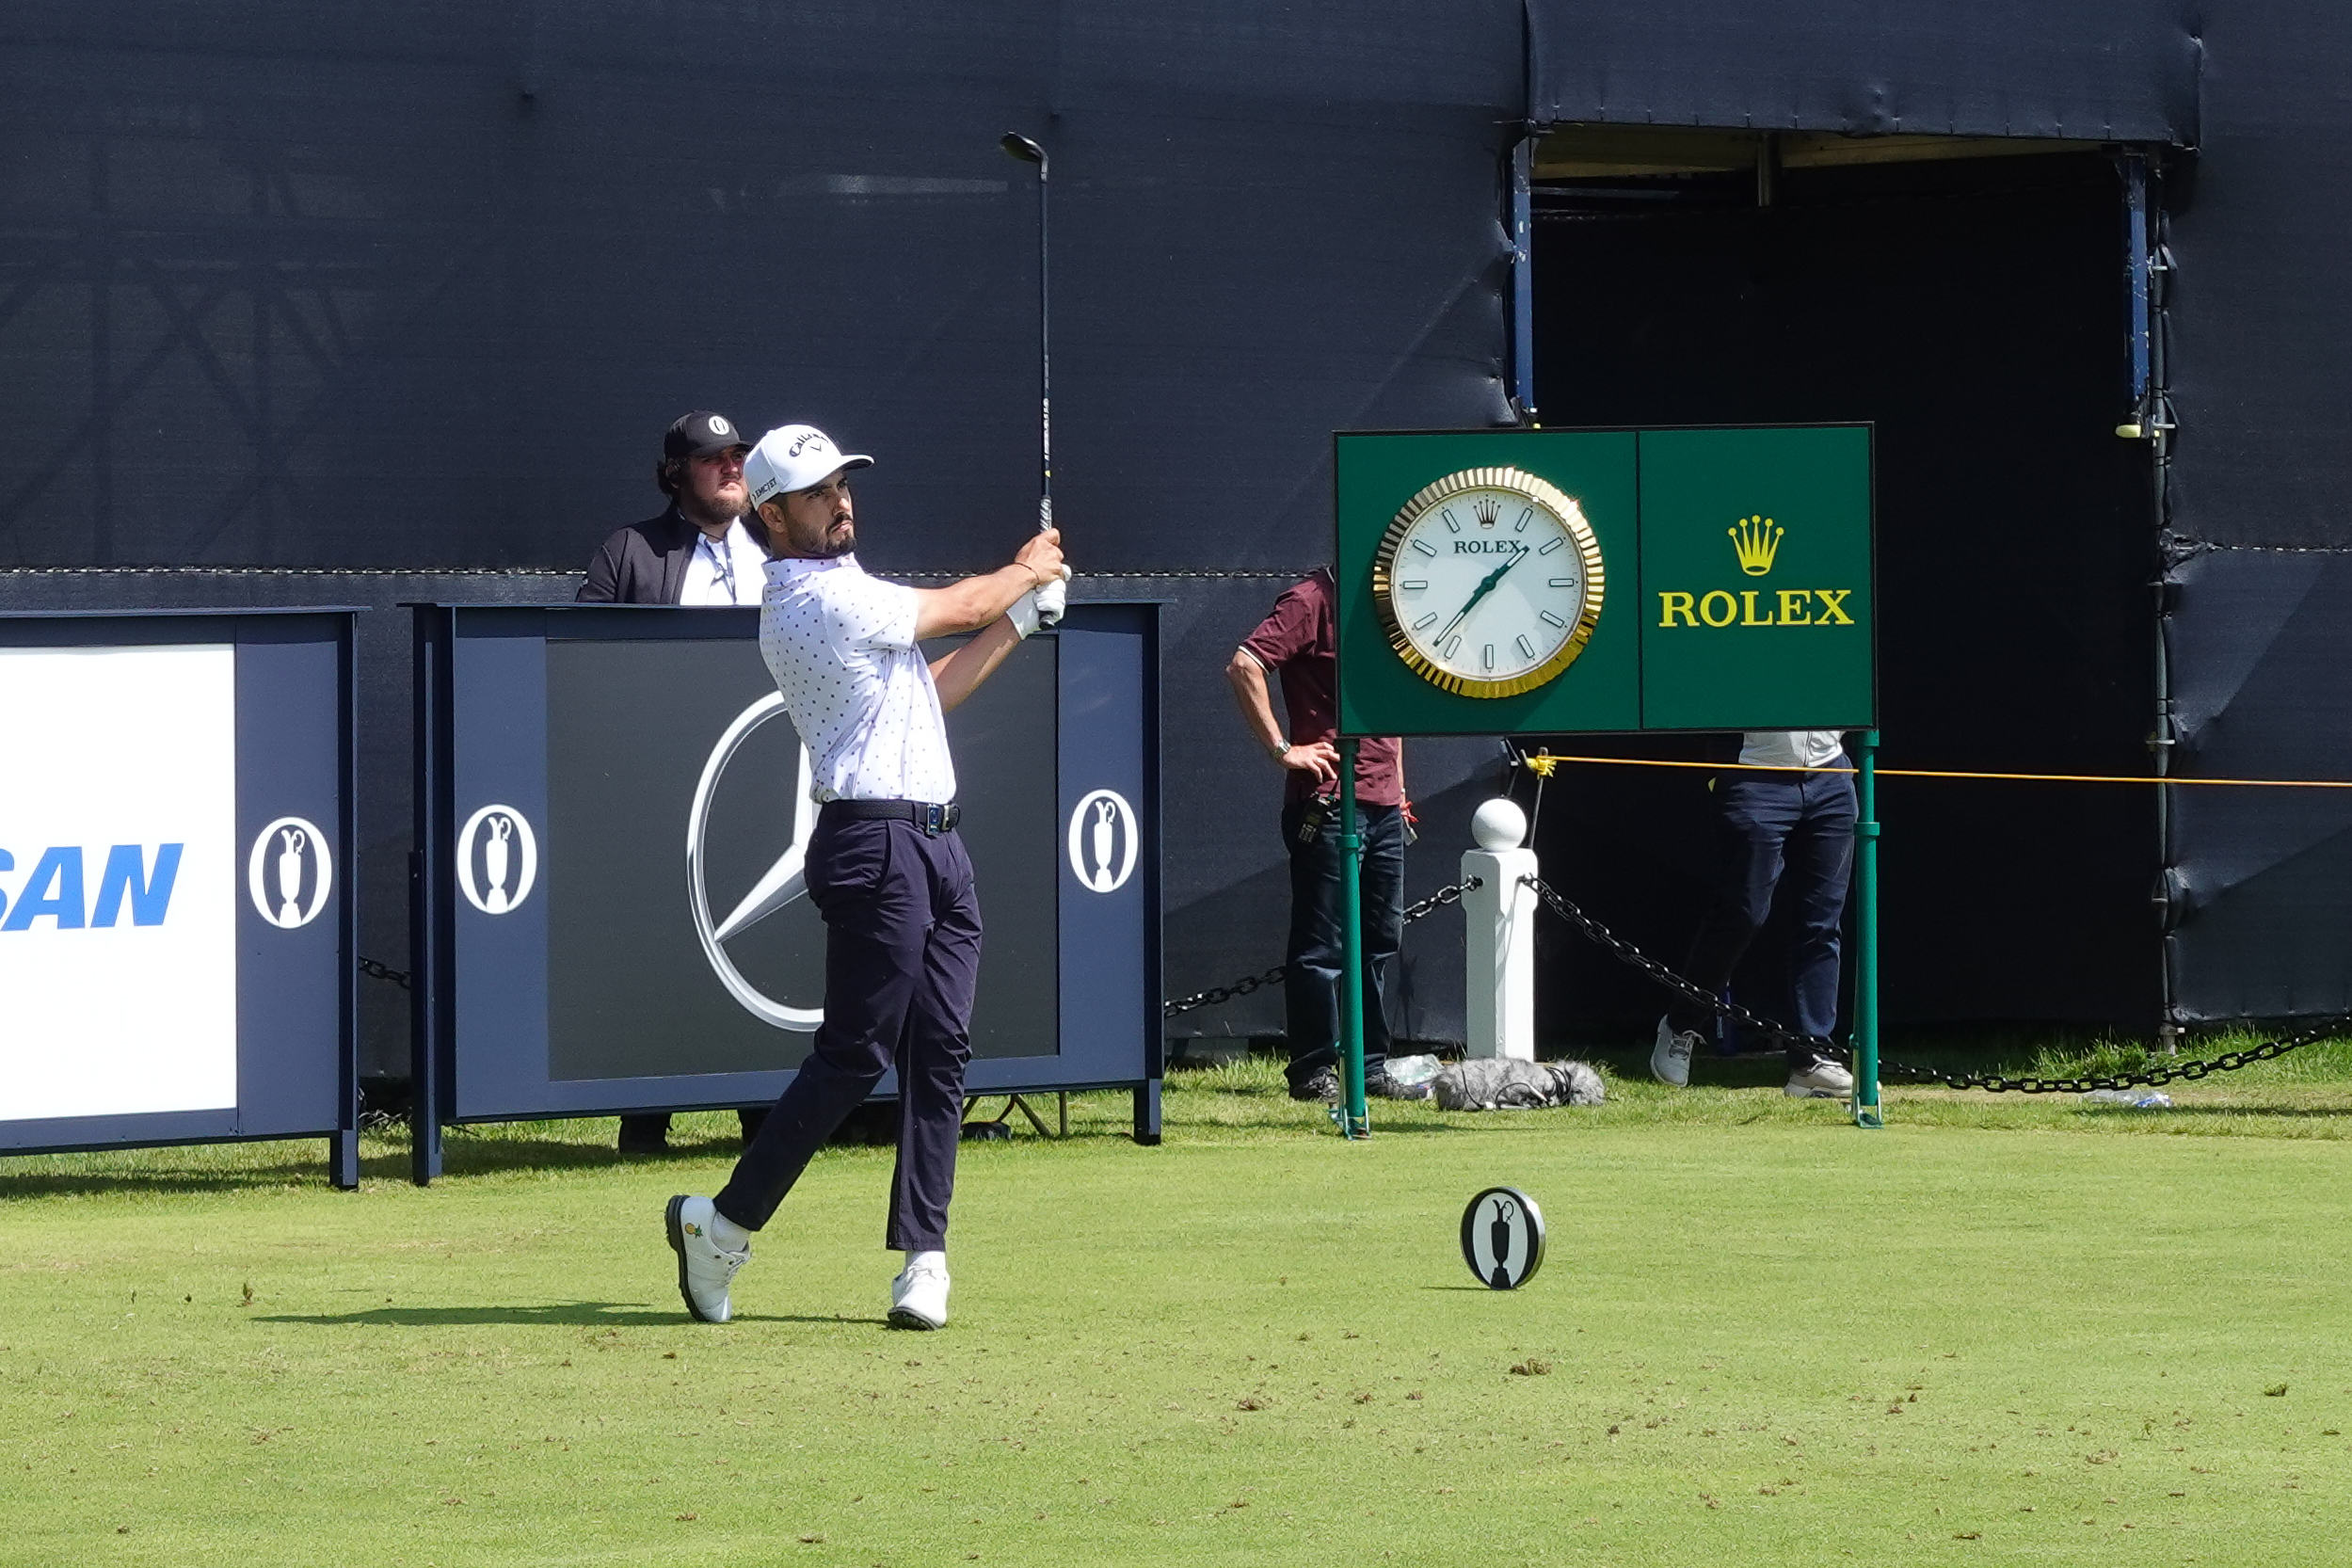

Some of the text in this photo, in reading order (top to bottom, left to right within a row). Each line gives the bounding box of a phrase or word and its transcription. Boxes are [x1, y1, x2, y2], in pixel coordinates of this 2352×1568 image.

[1453, 540, 1522, 554] ROLEX
[1657, 589, 1855, 628] ROLEX
[0, 842, 184, 932] AN
